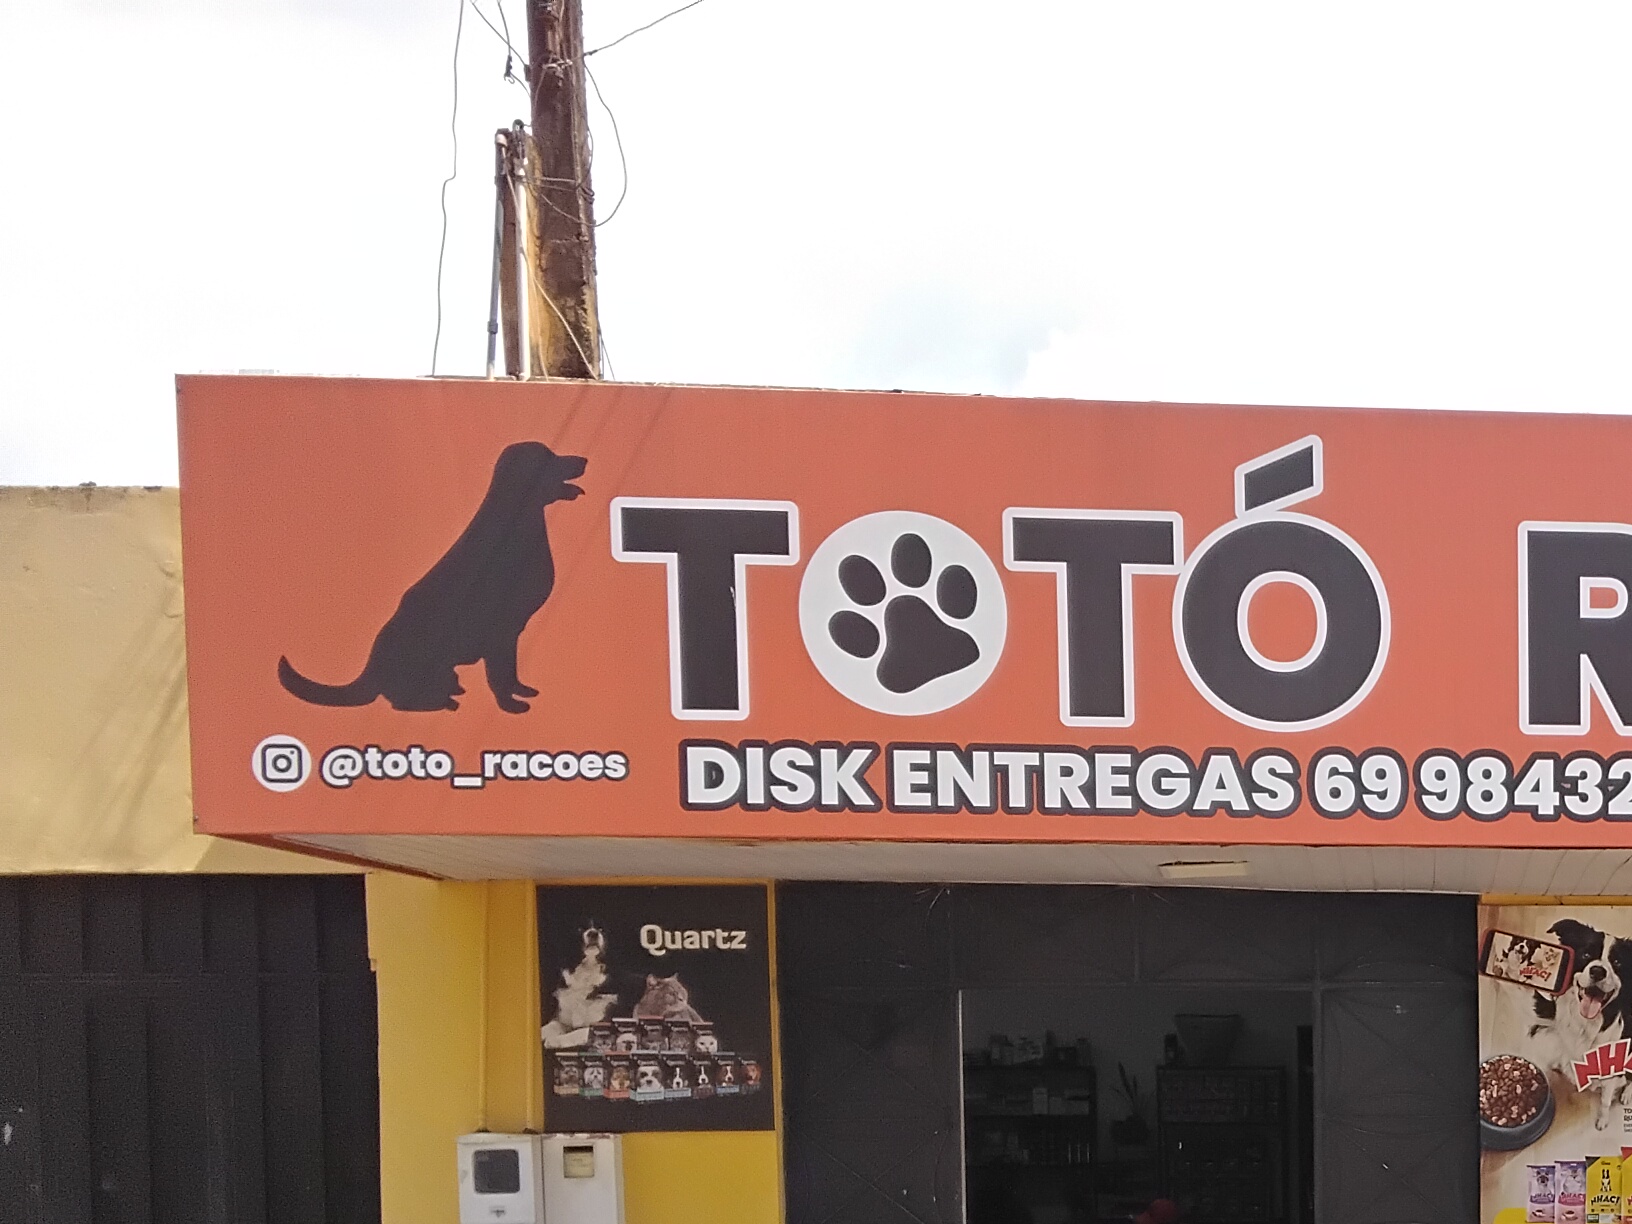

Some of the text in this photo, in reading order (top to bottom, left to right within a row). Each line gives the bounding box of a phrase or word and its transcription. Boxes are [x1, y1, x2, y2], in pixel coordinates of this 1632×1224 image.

[321, 745, 628, 788] @toto_racoes
[683, 741, 881, 810] DISK
[889, 744, 1301, 816] ENTREGAS
[1311, 750, 1415, 819] 69
[640, 924, 747, 956] Quartz
